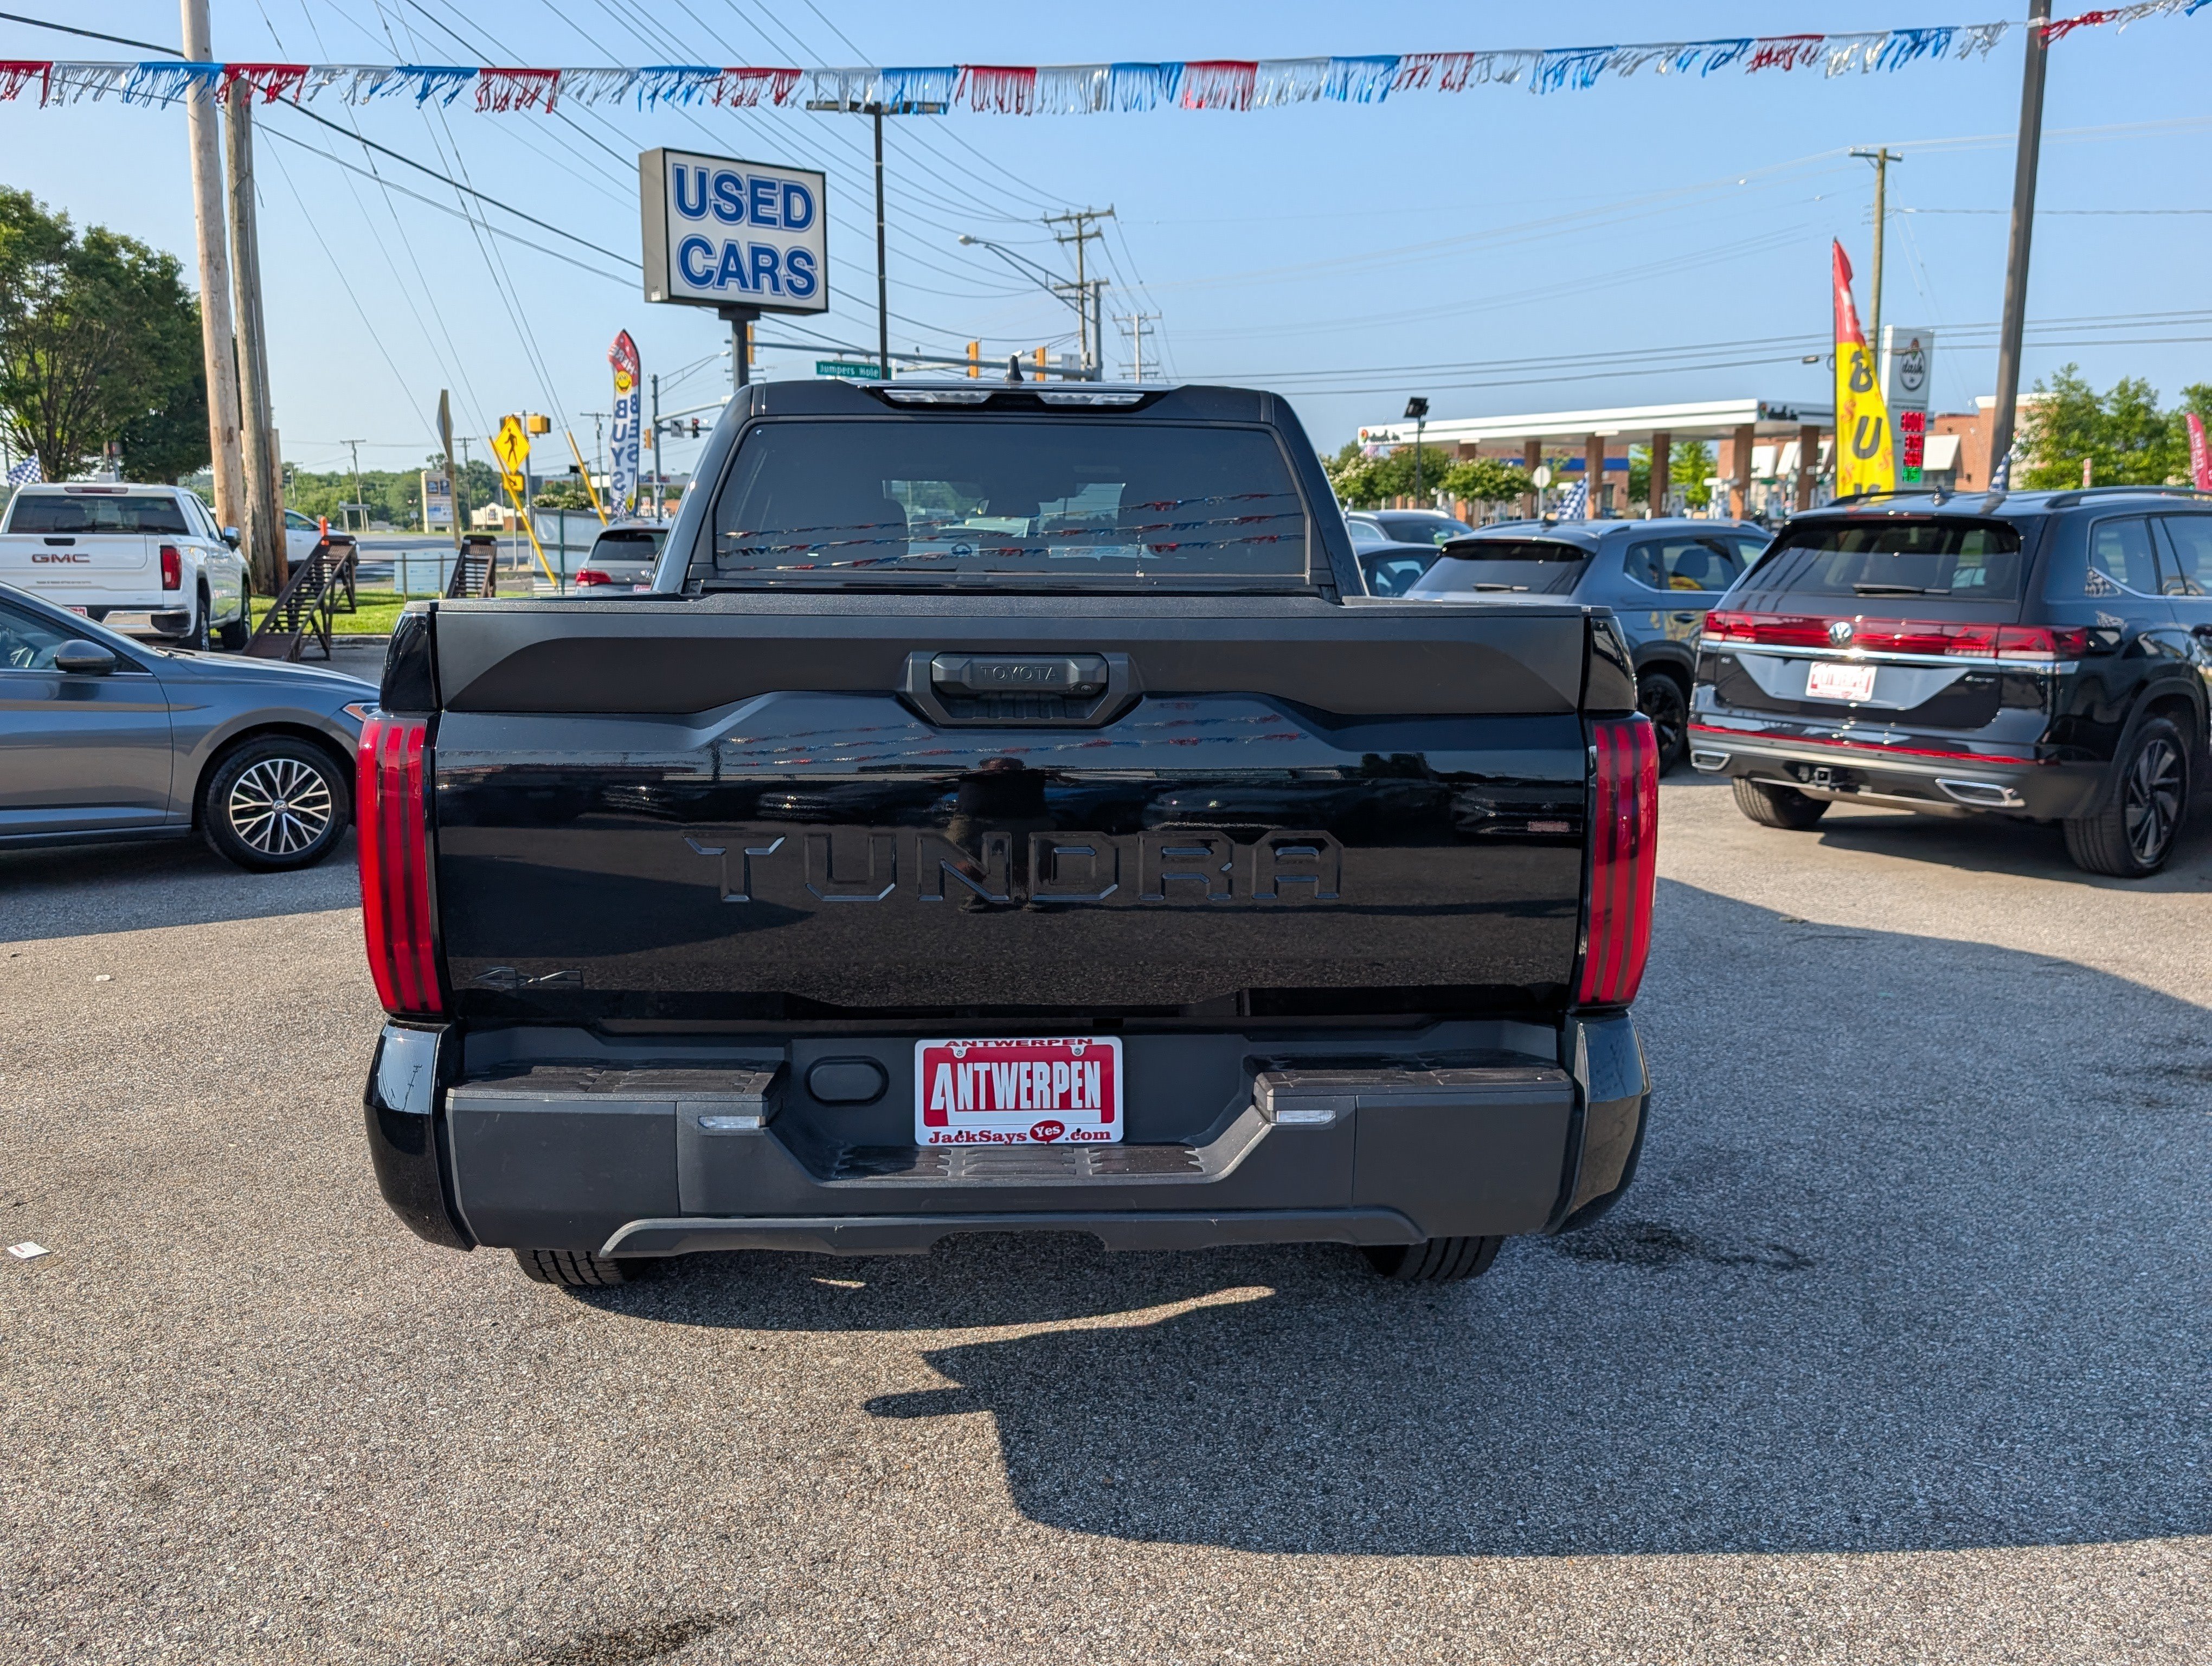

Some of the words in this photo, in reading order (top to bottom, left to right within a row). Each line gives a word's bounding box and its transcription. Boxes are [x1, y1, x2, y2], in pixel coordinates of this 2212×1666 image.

[673, 163, 816, 232] USED
[677, 234, 819, 299] CARS
[820, 364, 855, 375] Jumpers
[859, 367, 879, 377] Hole
[31, 553, 91, 563] GMC
[980, 665, 1057, 682] TOYOTA
[681, 829, 1344, 902] TUNDRA
[944, 1039, 1093, 1047] ANTWERPEN
[930, 1061, 1101, 1111] ANTWERPEN
